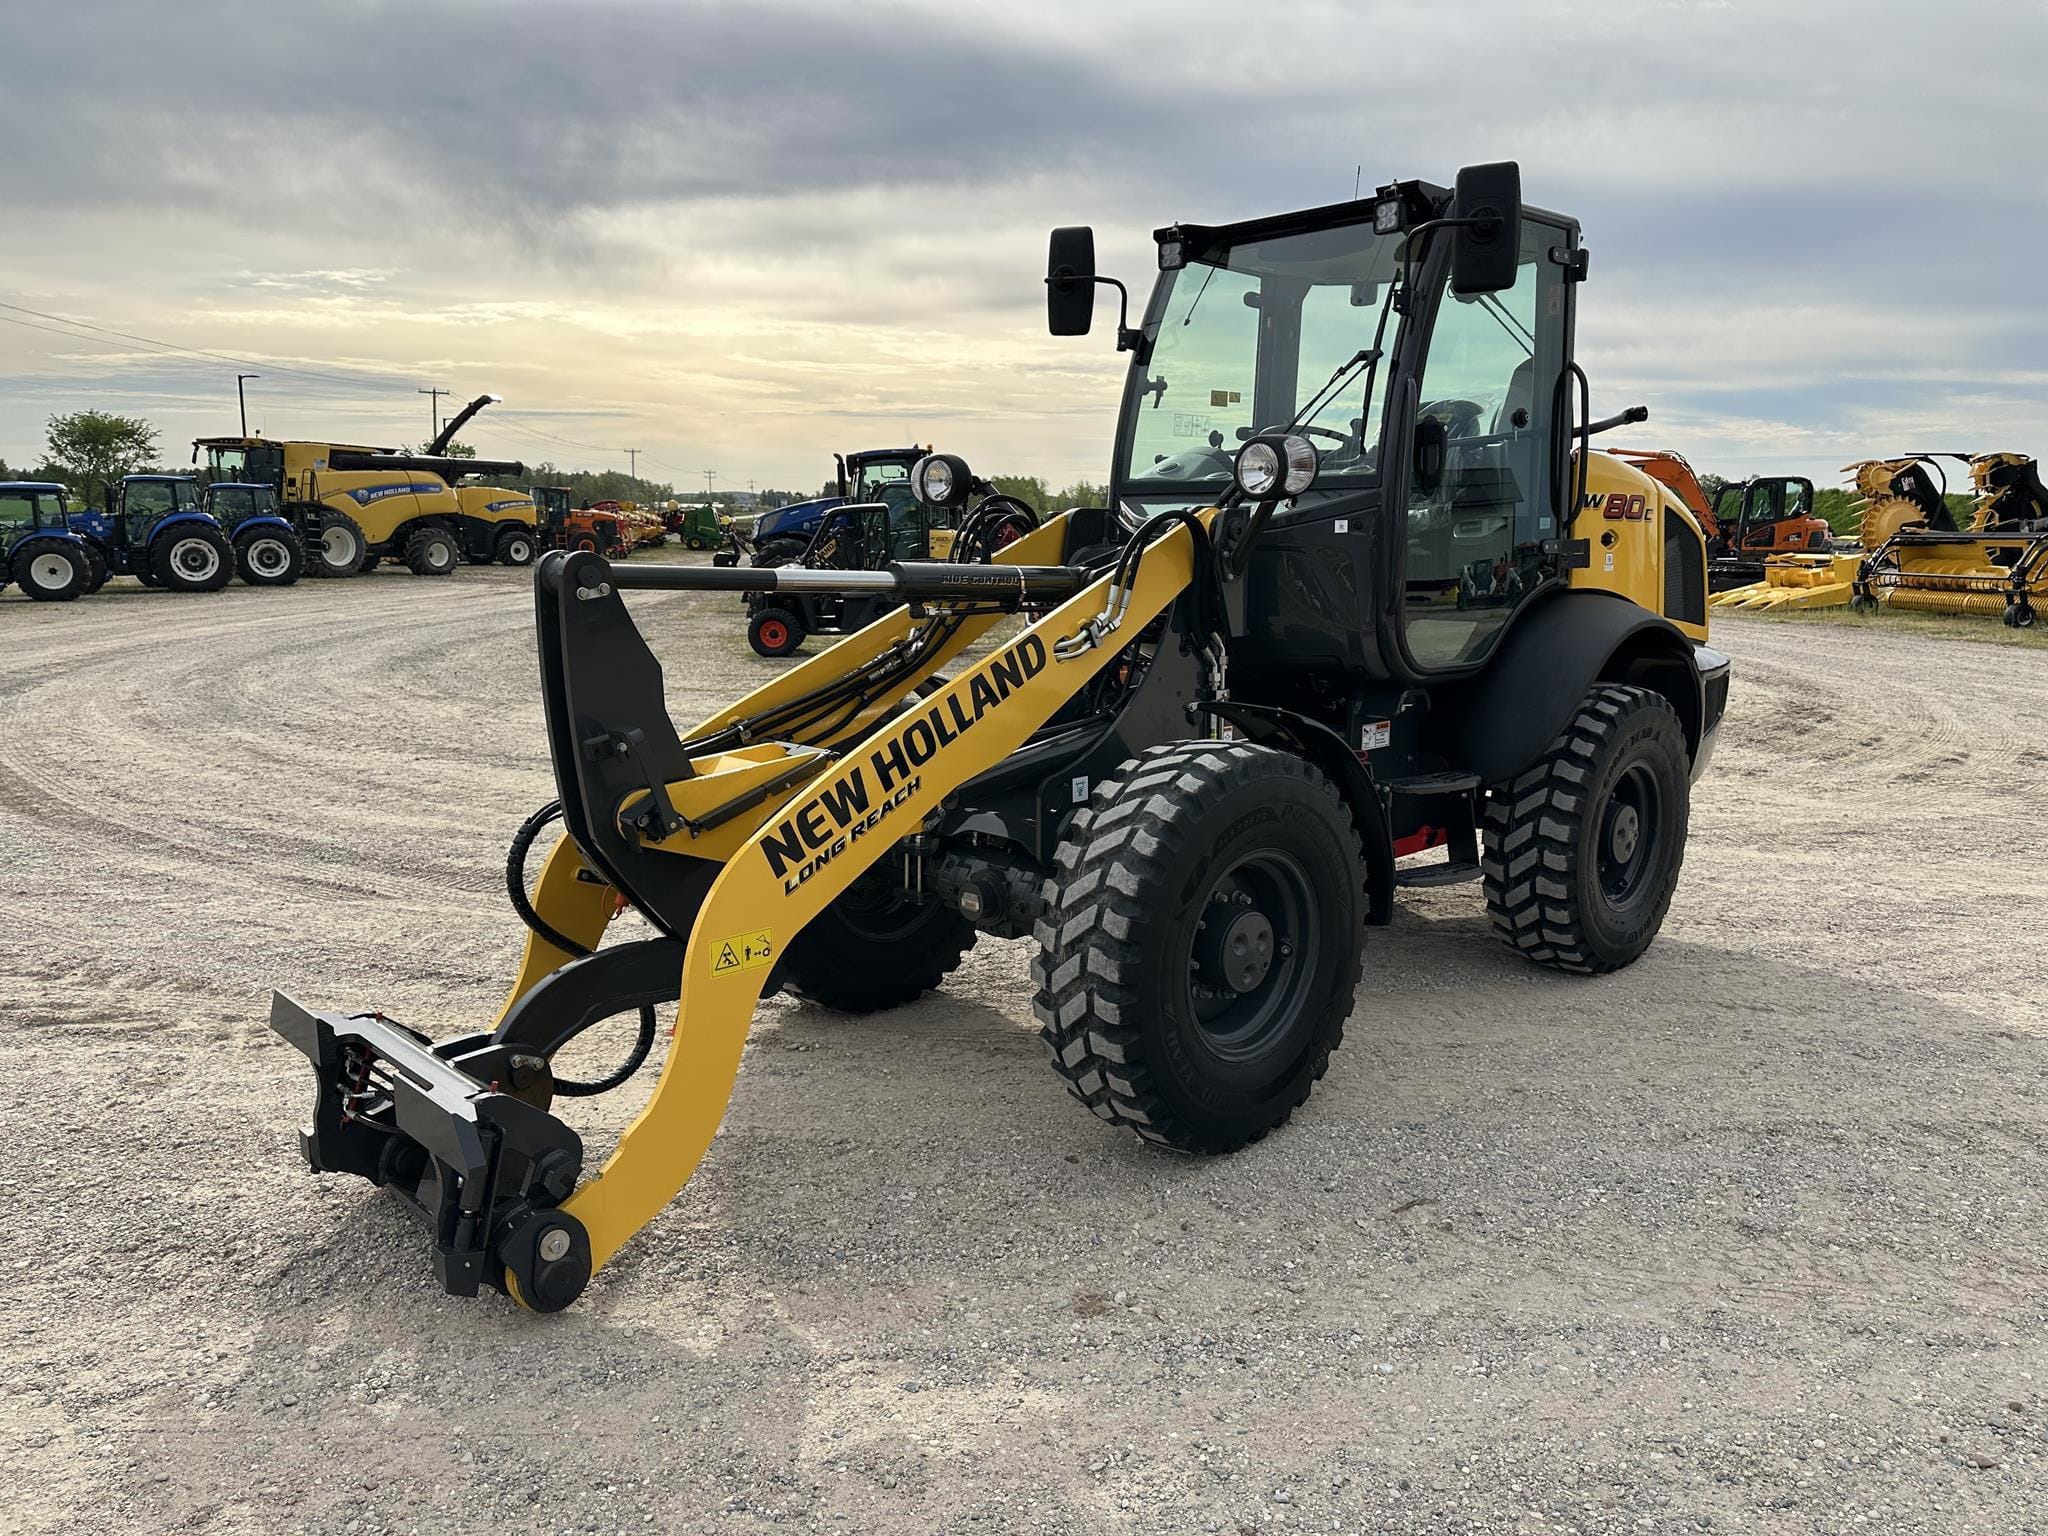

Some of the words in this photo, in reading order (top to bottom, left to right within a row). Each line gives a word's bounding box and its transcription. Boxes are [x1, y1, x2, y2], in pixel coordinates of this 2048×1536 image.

[370, 492, 384, 500] NEW
[384, 486, 411, 496] HOLLAND
[942, 574, 969, 585] RIDE
[759, 766, 870, 880] NEW
[870, 633, 1047, 793] HOLLAND
[784, 834, 848, 897] LONG
[850, 774, 922, 844] REACH
